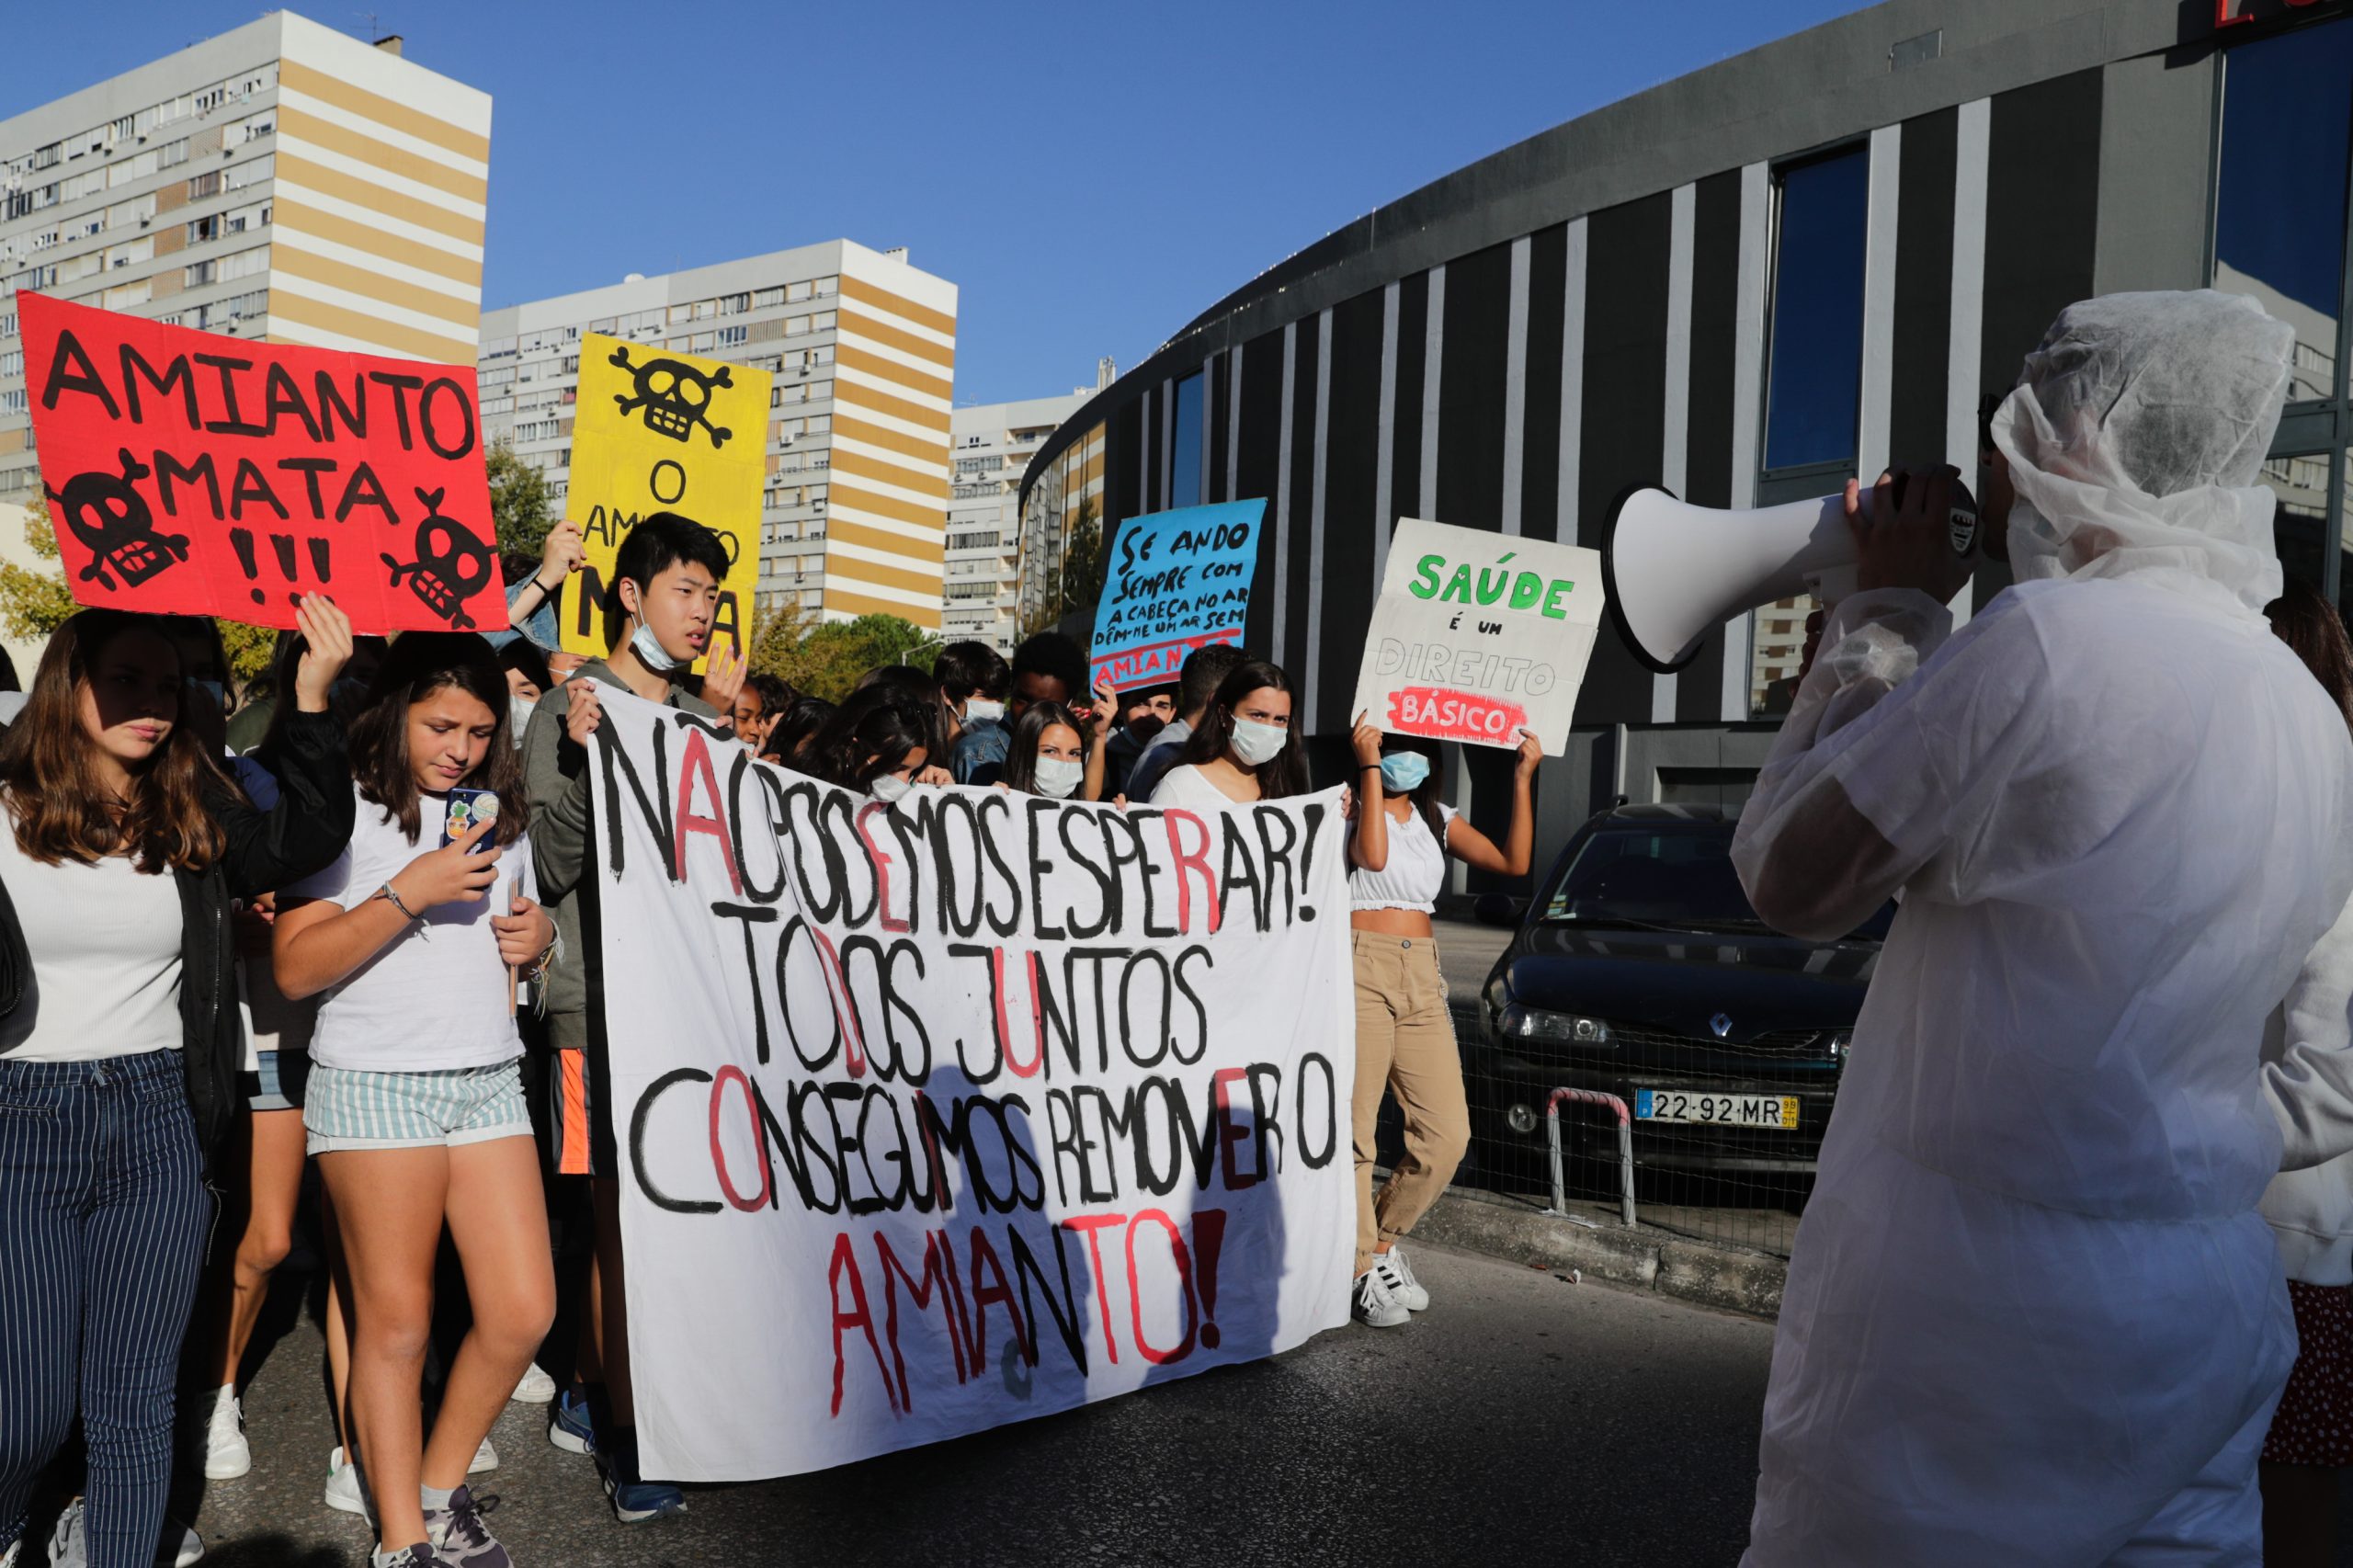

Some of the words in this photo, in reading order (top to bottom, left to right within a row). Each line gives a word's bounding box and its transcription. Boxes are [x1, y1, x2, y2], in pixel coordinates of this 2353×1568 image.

[41, 329, 476, 460] AMIANTO
[153, 449, 402, 526] MATA
[649, 460, 687, 505] O
[1117, 525, 1158, 576] SE
[1169, 522, 1250, 556] ANDO
[577, 564, 742, 662] MA
[1107, 608, 1122, 628] A
[1127, 598, 1190, 622] CABEÇA
[1194, 593, 1218, 612] NO
[1222, 586, 1249, 605] AR
[1111, 564, 1194, 606] SEMPRE
[1201, 562, 1244, 581] COM
[1408, 551, 1575, 619] SAÚDE
[1154, 620, 1176, 634] UM
[1179, 615, 1201, 629] AR
[1202, 608, 1245, 631] SEM
[1449, 611, 1464, 631] É
[1477, 620, 1503, 635] UM
[1094, 639, 1230, 687] AMIAN
[1374, 637, 1556, 697] DIREITO
[1401, 690, 1507, 734] BÁSICO
[596, 702, 787, 904] NÃO
[1026, 798, 1326, 942] ESPERAR!
[710, 901, 933, 1088] TODOS
[948, 943, 1214, 1085] JUNTOS
[628, 1063, 1047, 1216] CONSEGUIMOS
[1044, 1061, 1284, 1208] REMOVER
[1296, 1051, 1336, 1170] O
[828, 1208, 1228, 1420] AMIANTO!
